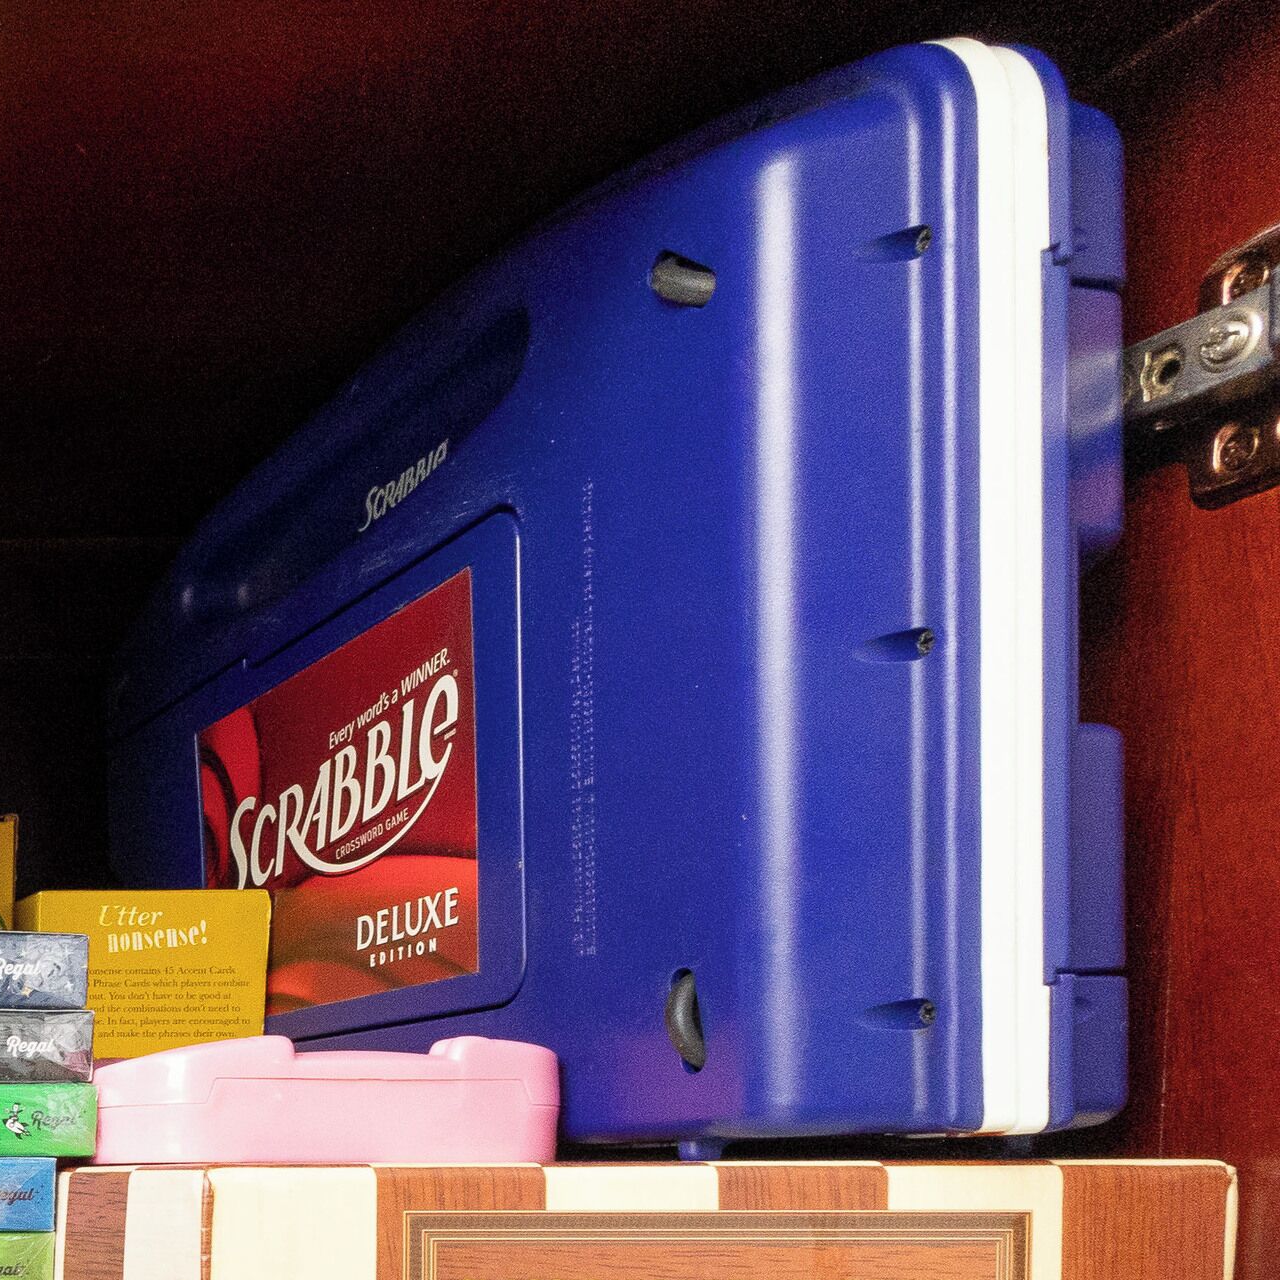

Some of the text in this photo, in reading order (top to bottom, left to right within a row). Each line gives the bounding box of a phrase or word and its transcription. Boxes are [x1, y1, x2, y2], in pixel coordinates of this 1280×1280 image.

[328, 647, 451, 750] Every word's a WINNER.
[355, 887, 460, 951] DELUXE
[368, 938, 439, 968] EDITION
[140, 1017, 170, 1027] players
[188, 1017, 240, 1027] encouraged
